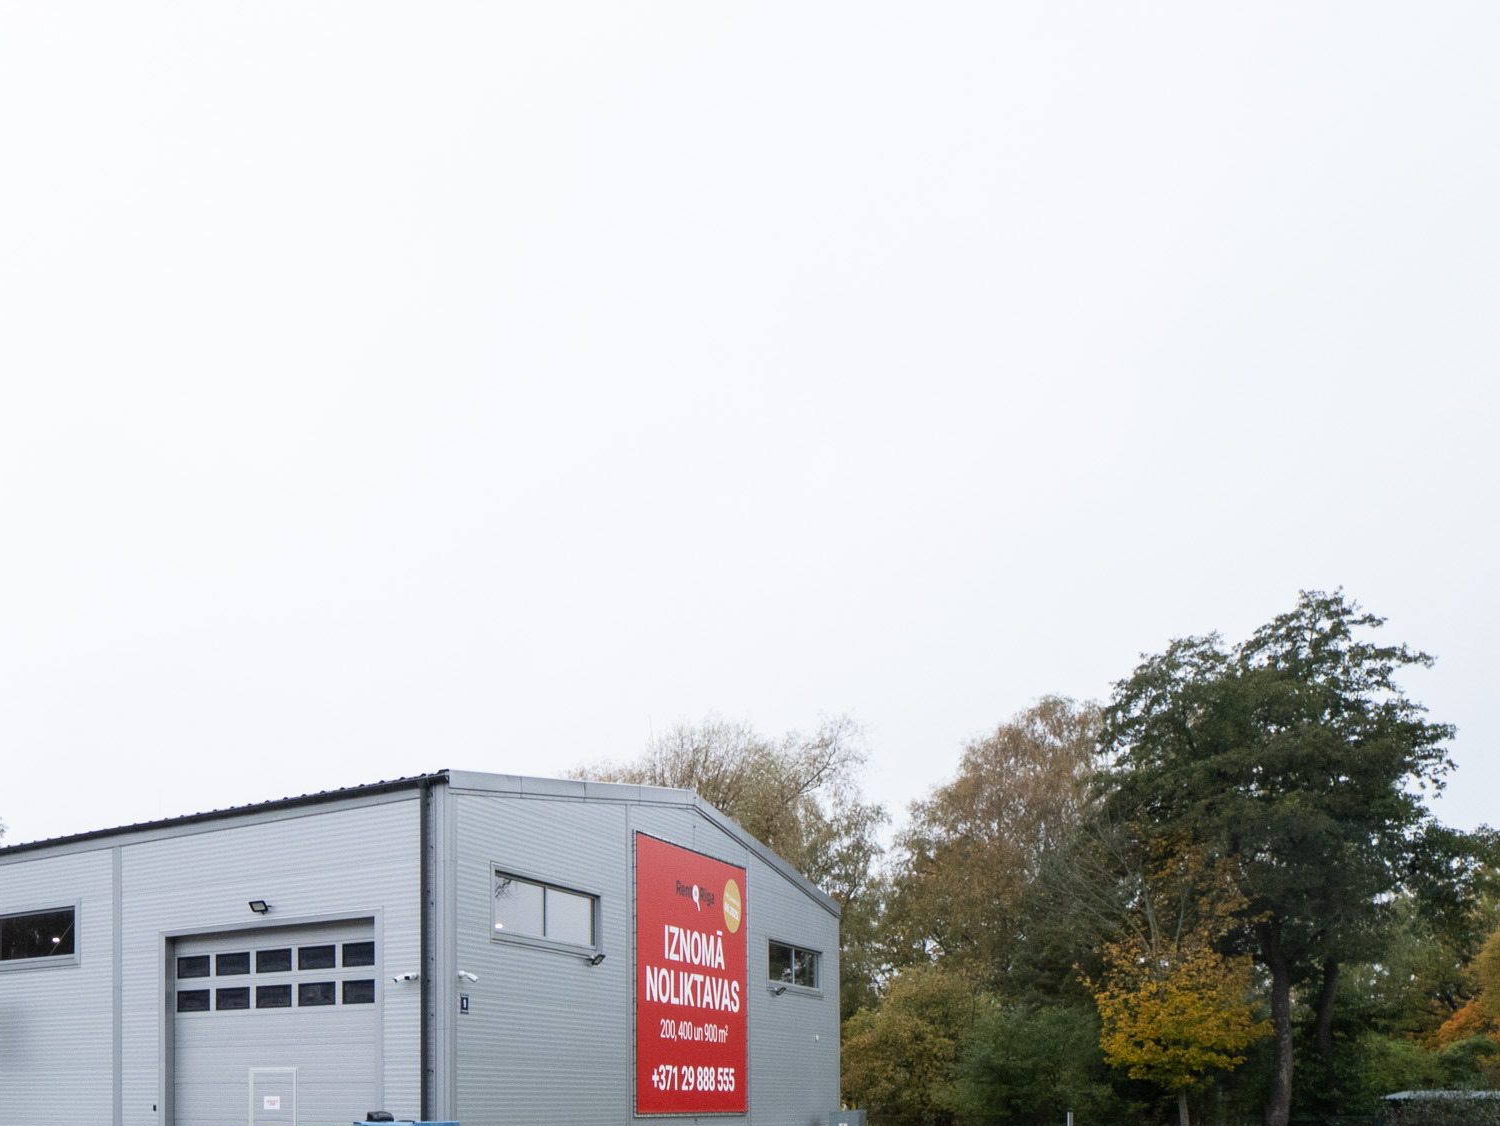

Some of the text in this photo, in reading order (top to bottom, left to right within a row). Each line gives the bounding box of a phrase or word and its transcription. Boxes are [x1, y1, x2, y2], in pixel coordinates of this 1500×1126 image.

[676, 880, 693, 898] Rent
[699, 887, 714, 906] Riga
[664, 924, 725, 970] IZNOMĀ
[645, 965, 740, 1013] NOLIKTAVAS
[660, 1018, 677, 1042] 200,
[678, 1021, 693, 1040] 400
[693, 1026, 704, 1041] un
[704, 1023, 718, 1043] 900
[651, 1064, 736, 1092] +371 29 888 555
